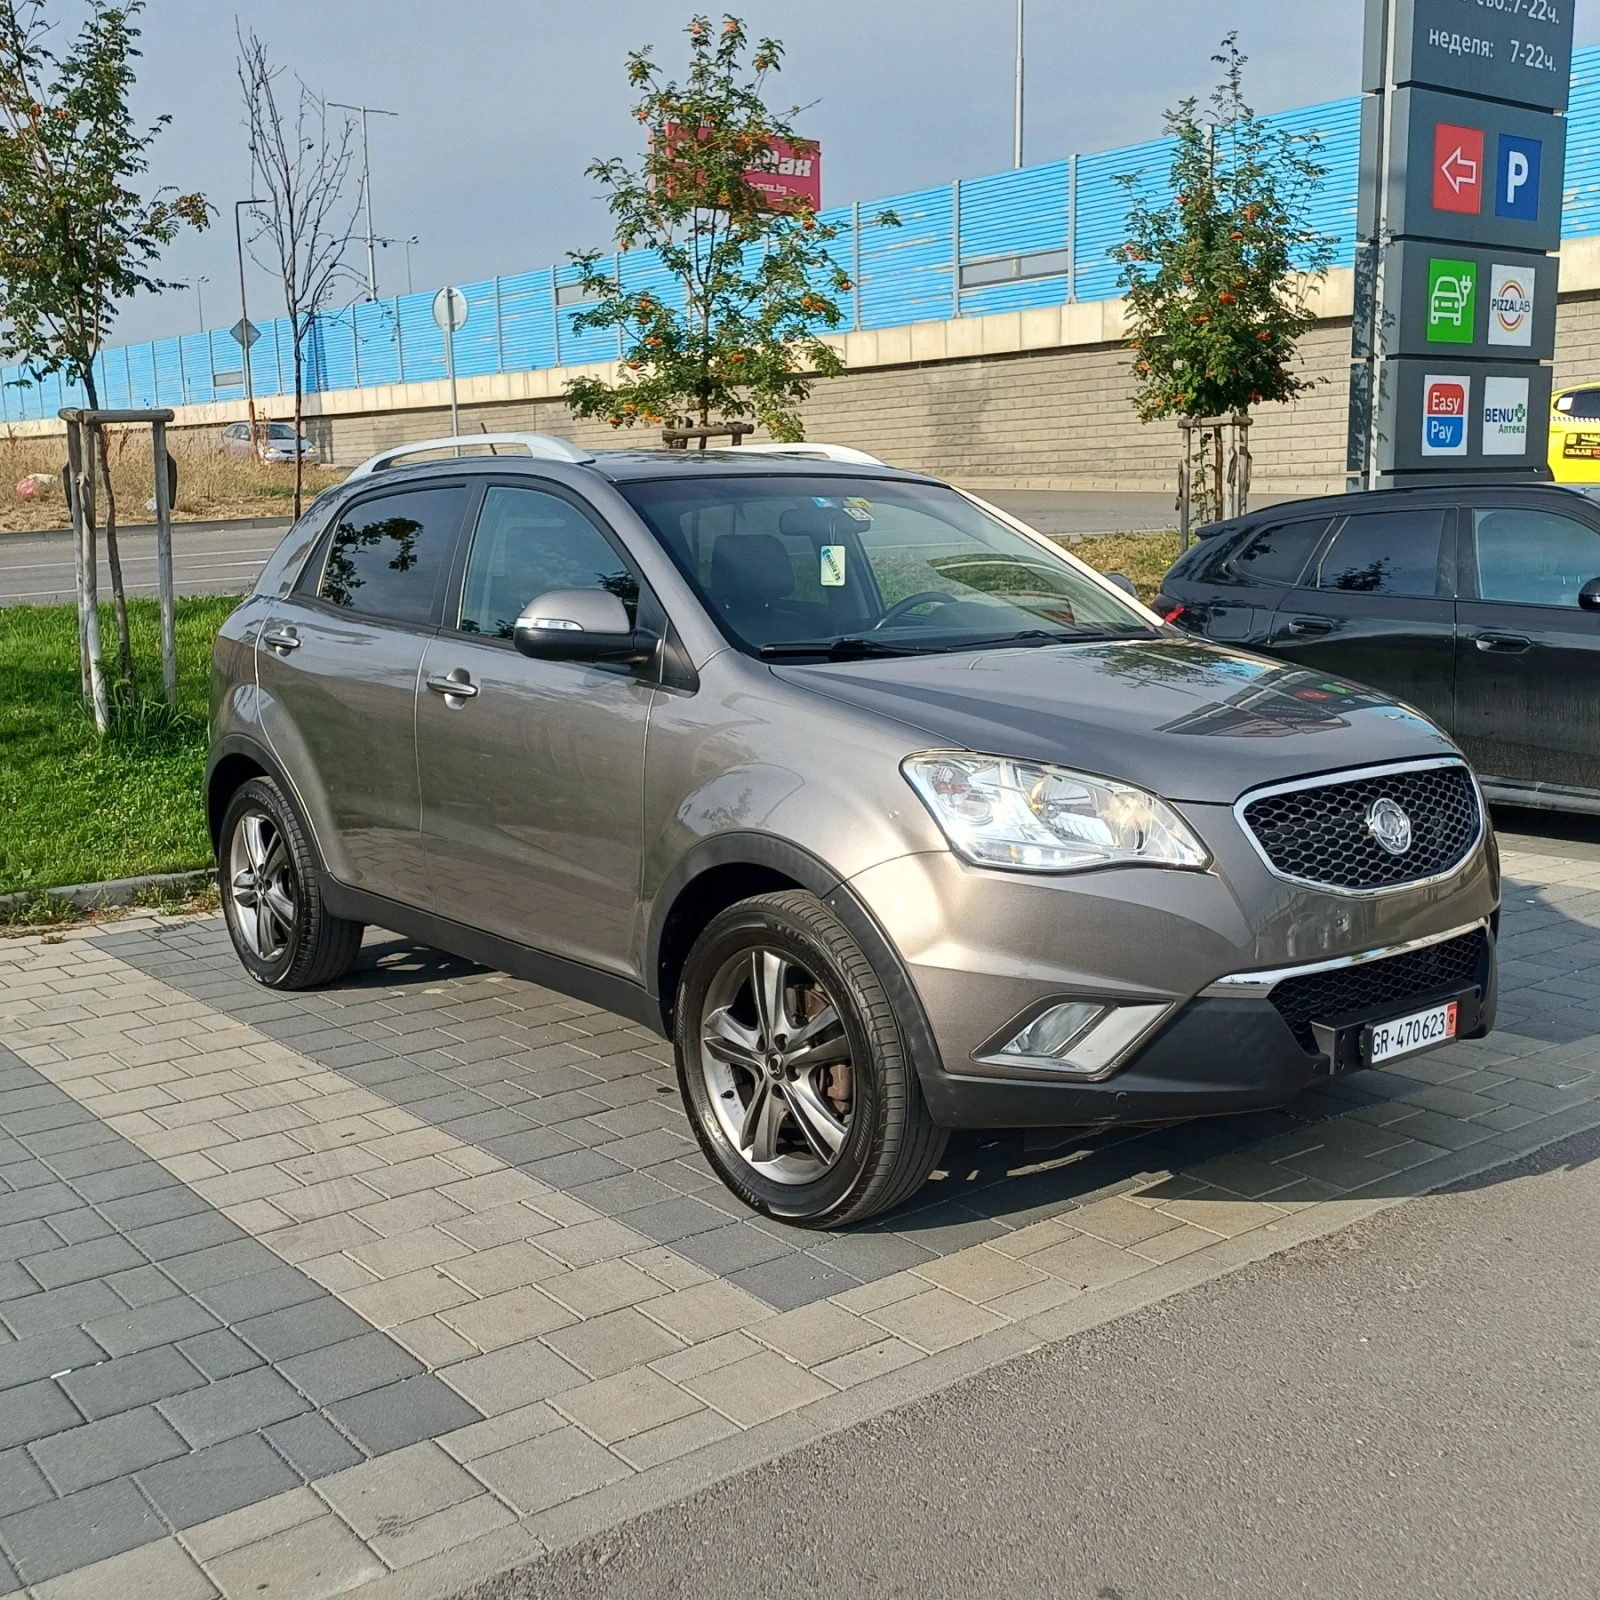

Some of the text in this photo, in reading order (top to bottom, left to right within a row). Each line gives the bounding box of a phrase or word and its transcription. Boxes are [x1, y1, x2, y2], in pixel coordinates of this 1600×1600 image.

[1428, 28, 1558, 72] неделя: 7-22ч.
[1506, 150, 1529, 204] P
[1491, 298, 1531, 313] PIZZALAB
[1431, 391, 1461, 415] Easy
[1484, 407, 1515, 423] BENU
[1430, 420, 1454, 444] Pay
[1497, 423, 1526, 435] Аптека
